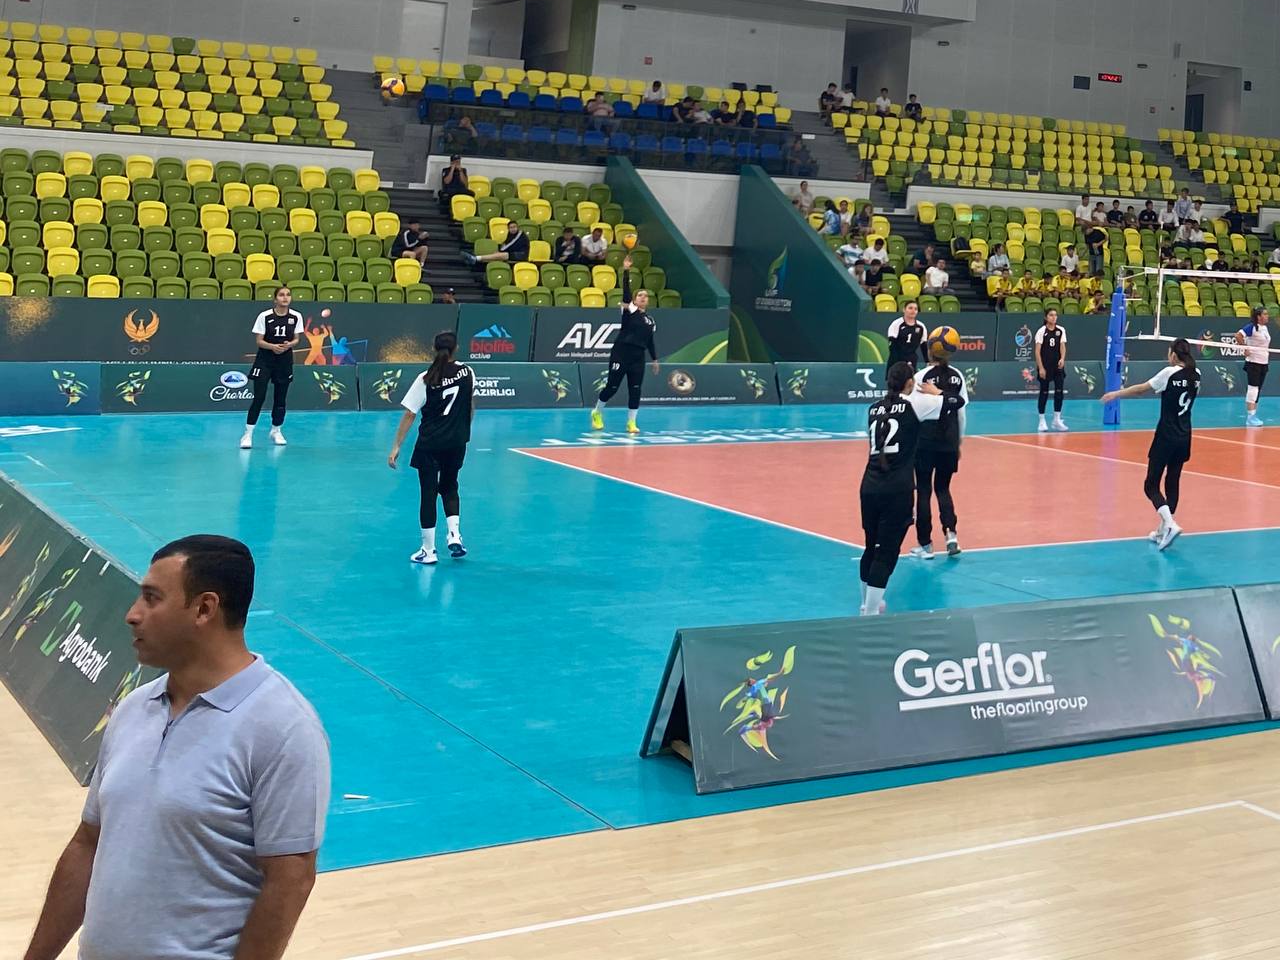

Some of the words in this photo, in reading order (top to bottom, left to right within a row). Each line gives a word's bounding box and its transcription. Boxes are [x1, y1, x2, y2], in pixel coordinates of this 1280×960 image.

[274, 325, 287, 337] 11
[557, 323, 622, 349] AVC
[905, 333, 912, 343] 1
[1049, 337, 1056, 347] 8
[470, 339, 515, 353] biolife
[958, 340, 986, 351] noh
[252, 368, 260, 377] 11
[473, 380, 499, 388] PORT
[473, 388, 516, 396] AZIRLIGI
[442, 386, 460, 416] 7
[870, 418, 900, 455] 12
[59, 622, 112, 683] Agrobank
[894, 642, 1048, 696] Gerflor
[971, 695, 1088, 720] theflooringroup
